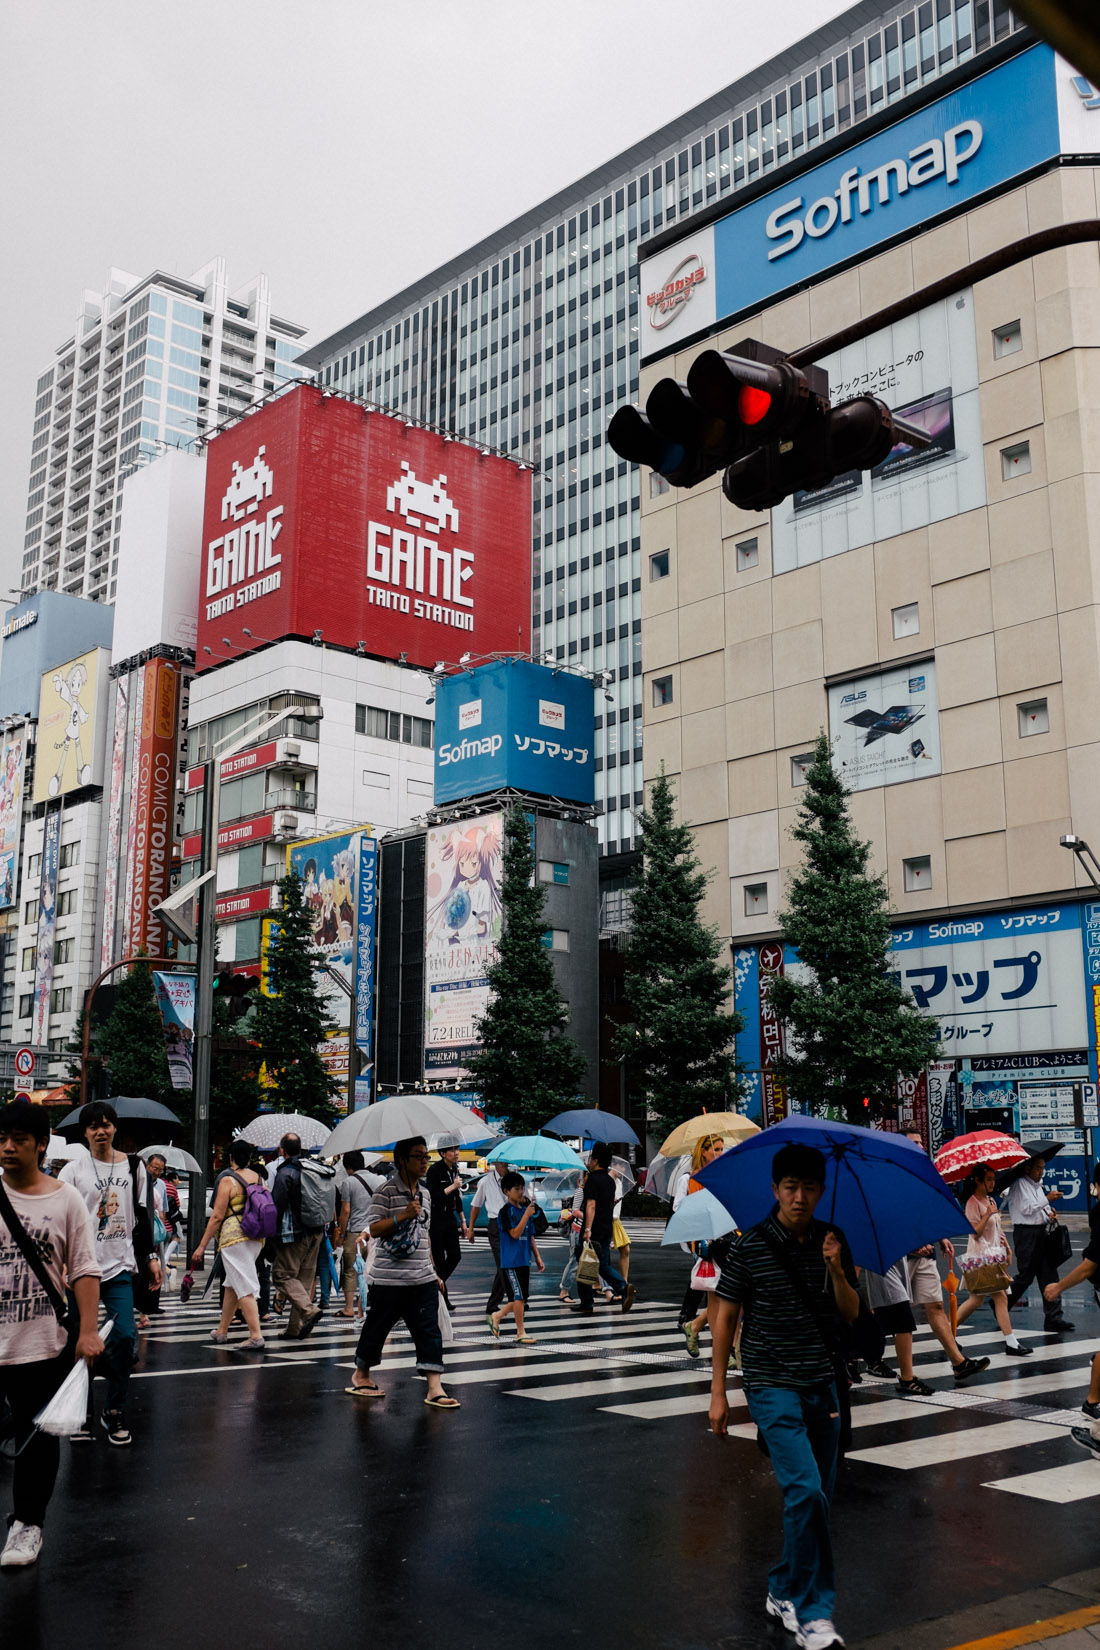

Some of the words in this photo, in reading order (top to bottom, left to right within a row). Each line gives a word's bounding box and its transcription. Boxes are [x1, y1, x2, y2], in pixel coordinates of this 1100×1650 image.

[765, 120, 984, 262] Sofmap
[647, 266, 705, 307] ビックカメラ
[206, 505, 284, 598] GAME
[366, 520, 475, 608] GAME
[206, 593, 234, 621] TAITO
[236, 571, 282, 608] STATION
[366, 585, 410, 614] TAITO
[414, 599, 474, 632] STATION
[1, 610, 37, 637] animate
[840, 690, 867, 704] ASUS
[234, 753, 257, 770] STATION
[439, 734, 502, 766] Sofmap
[514, 734, 589, 764] ソフマップ
[229, 825, 253, 842] STATION
[361, 857, 375, 915] ソフマップ
[227, 897, 250, 914] STATION
[1001, 911, 1061, 929] ソフマップ
[929, 921, 984, 938] Sofmap
[883, 951, 1042, 1008] マップ
[766, 1083, 775, 1118] TRAVEL
[1084, 1086, 1094, 1104] P
[97, 1230, 127, 1242] Quality
